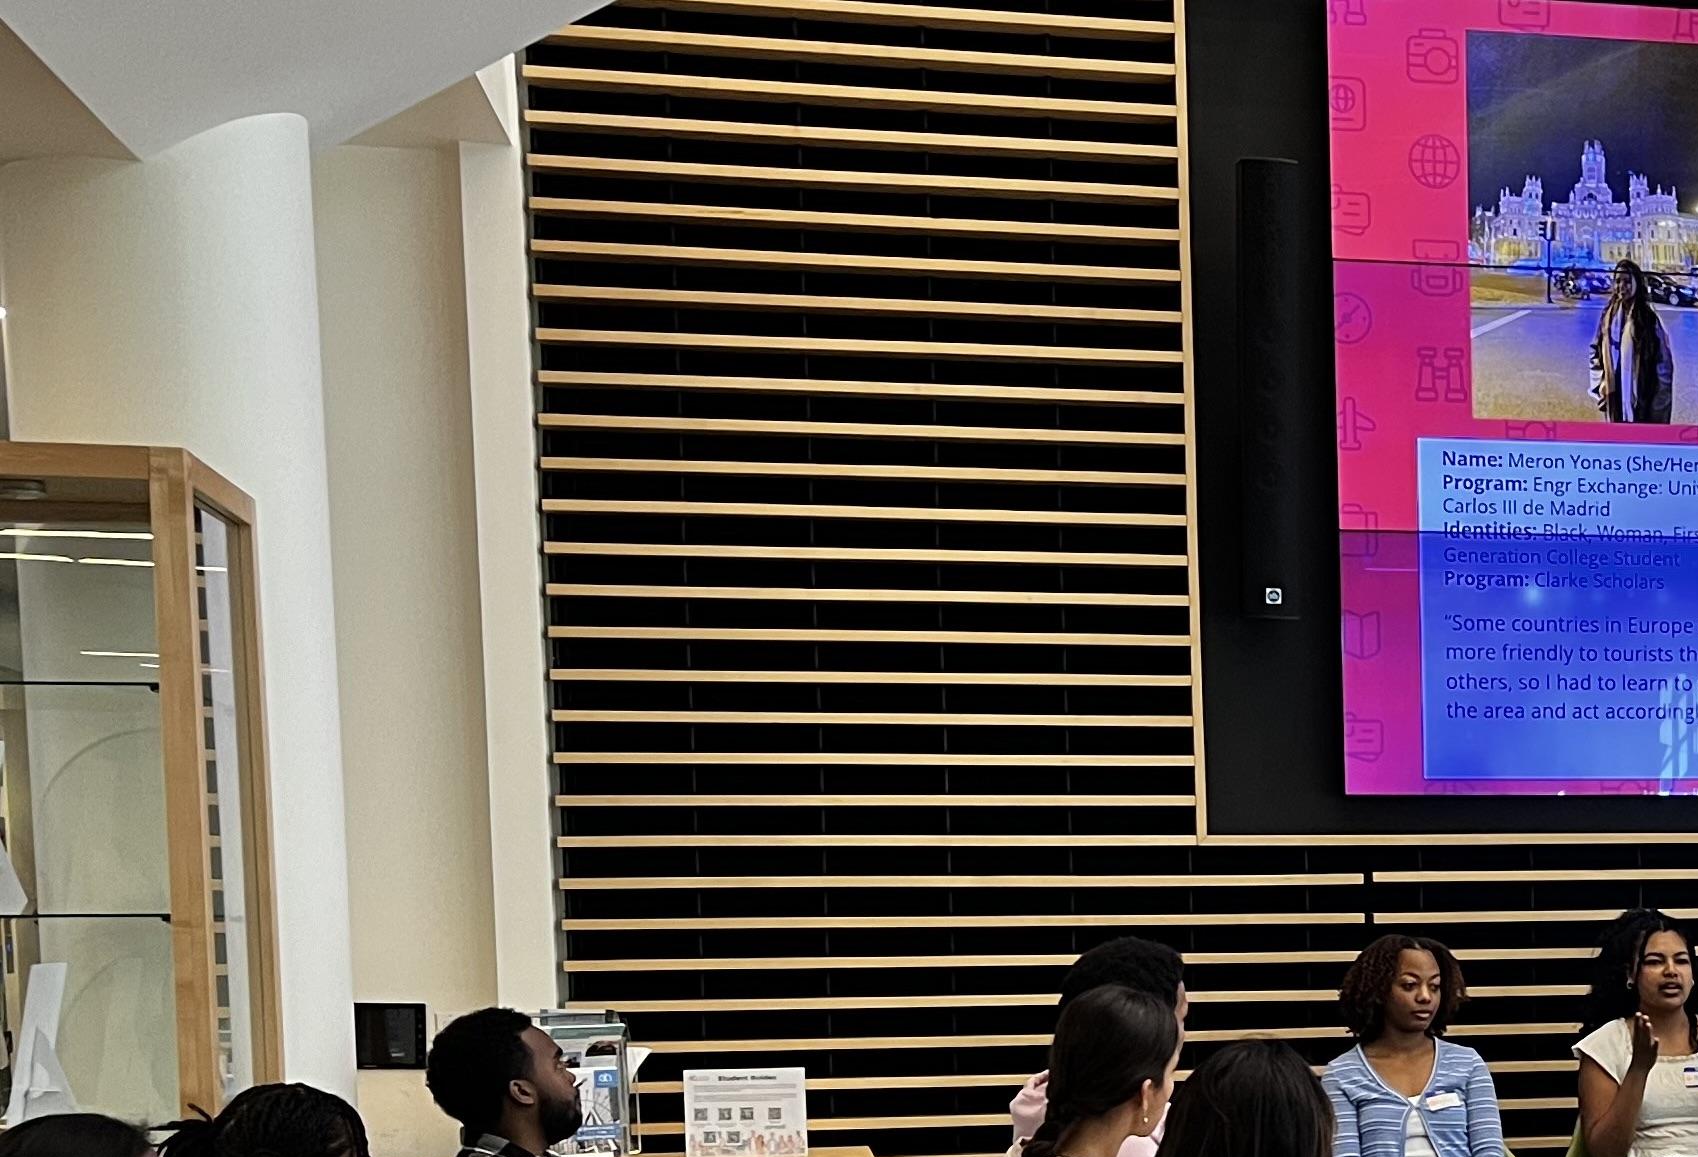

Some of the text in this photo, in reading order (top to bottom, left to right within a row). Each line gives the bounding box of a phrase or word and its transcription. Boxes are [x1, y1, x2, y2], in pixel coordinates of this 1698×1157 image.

[1442, 451, 1502, 467] Name:
[1509, 454, 1565, 469] Meron
[1570, 455, 1621, 471] Yonas
[1443, 475, 1528, 494] Program:
[1533, 478, 1571, 496] Engr
[1578, 479, 1662, 497] Exchange:
[1443, 498, 1610, 517] Carlos III de Madrid
[1444, 521, 1536, 539] Identities:
[1543, 524, 1593, 543] Black,
[1597, 526, 1667, 544] Woman,
[1444, 547, 1680, 569] Generation College Student
[1445, 571, 1664, 590] Program: Clarke Scholars
[1512, 616, 1599, 633] countries
[1606, 617, 1622, 633] in
[1629, 617, 1693, 638] Europe
[1446, 646, 1496, 661] more
[1503, 643, 1573, 665] friendly
[1579, 648, 1598, 662] to
[1604, 646, 1673, 663] tourists
[1447, 674, 1512, 693] others,
[1519, 678, 1540, 690] so
[1545, 675, 1551, 690] I
[1557, 674, 1590, 691] had
[1599, 676, 1615, 691] to
[1623, 674, 1668, 692] learn
[1675, 677, 1692, 692] to
[1447, 703, 1478, 718] the
[1484, 707, 1524, 718] area
[1532, 703, 1566, 719] and
[1573, 705, 1598, 719] act
